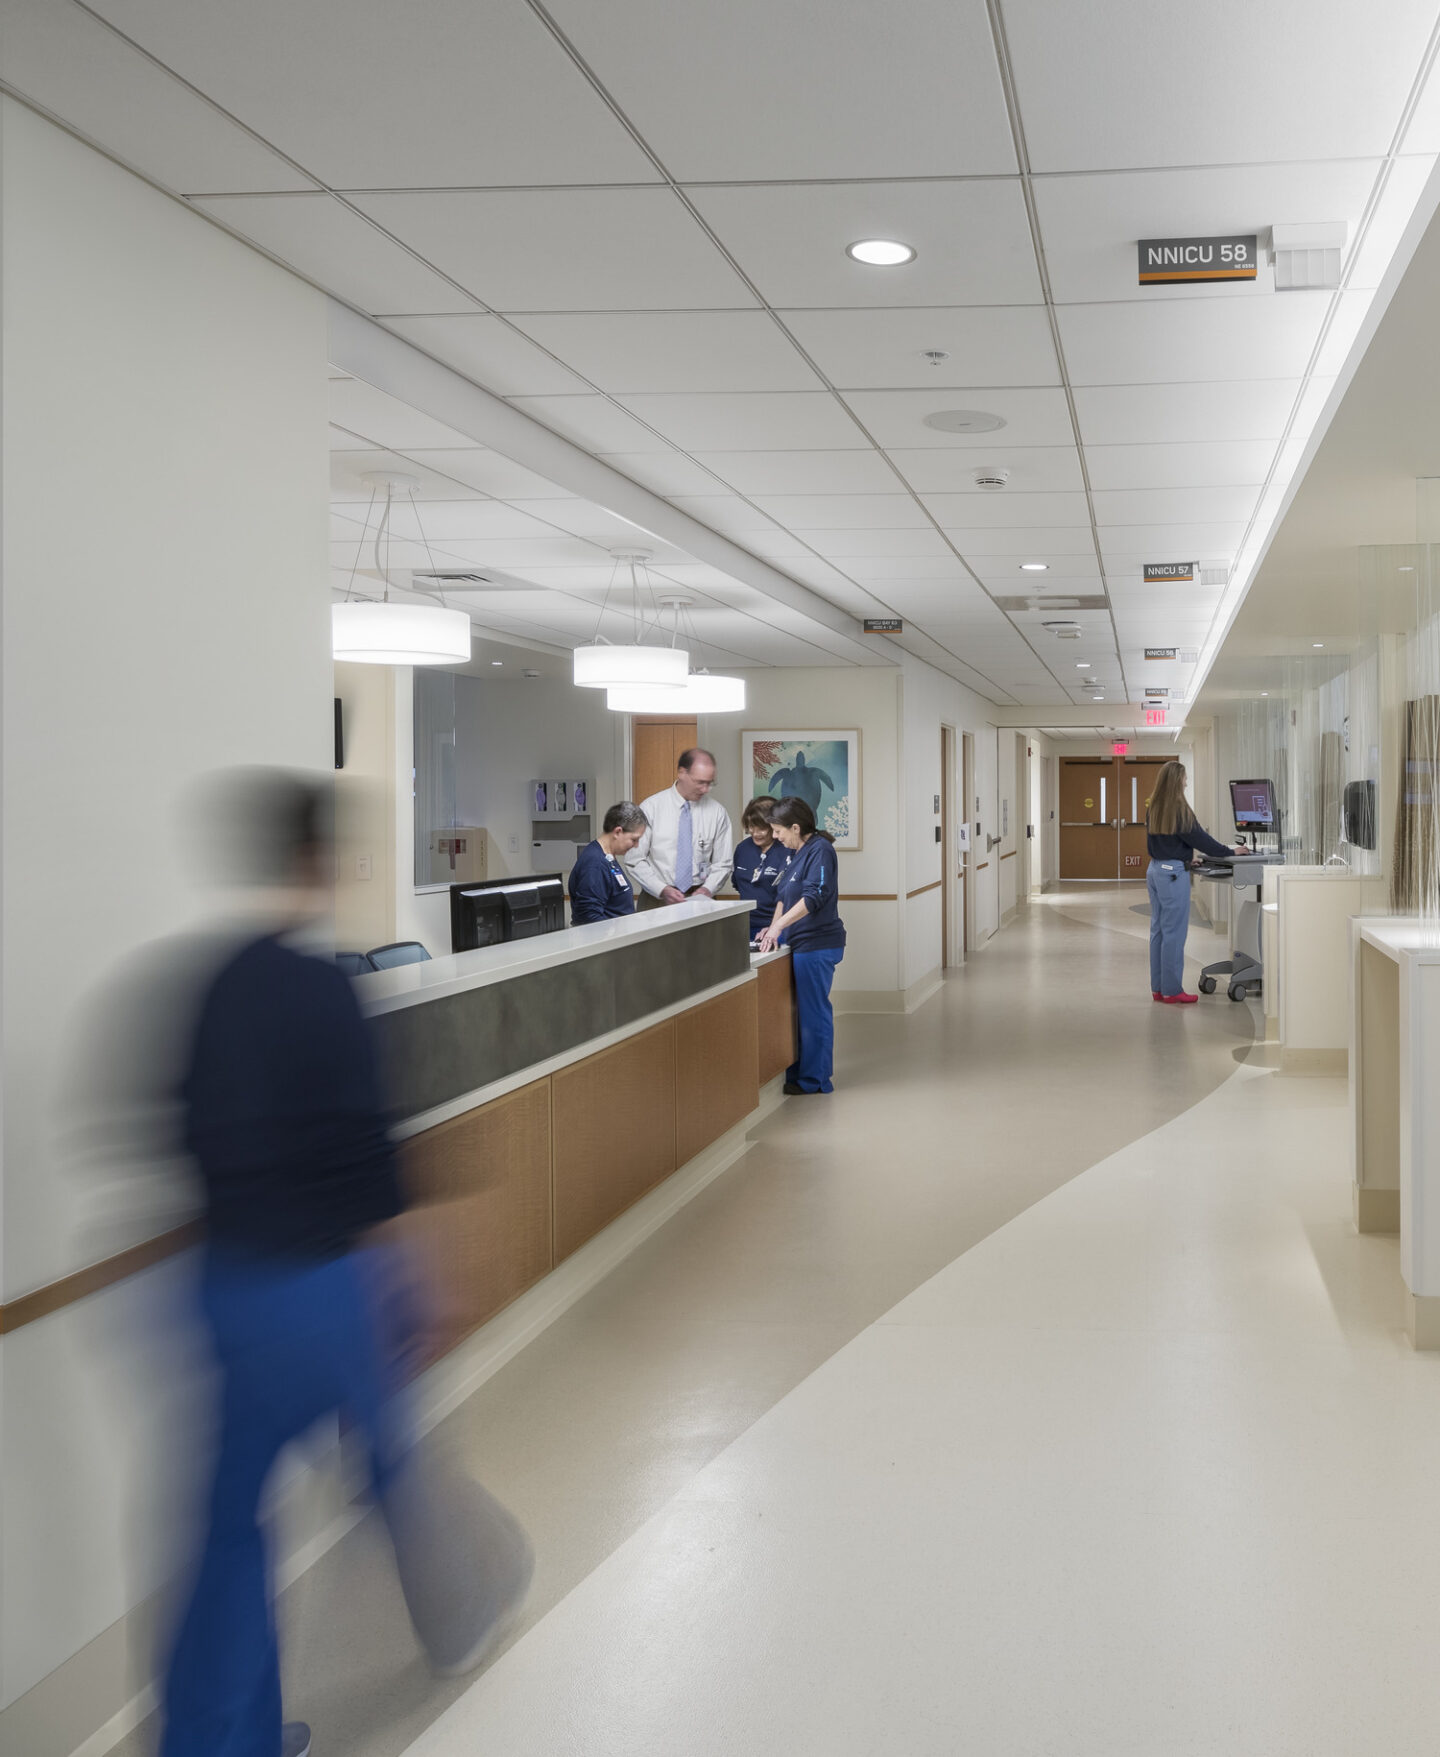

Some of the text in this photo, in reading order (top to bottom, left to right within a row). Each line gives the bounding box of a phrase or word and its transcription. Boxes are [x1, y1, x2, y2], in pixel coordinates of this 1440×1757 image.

[1148, 244, 1248, 265] NNICU 58
[1148, 566, 1176, 575] NNICU
[1178, 565, 1189, 574] 57
[1146, 710, 1166, 726] EXIT
[1125, 855, 1141, 866] EXIT
